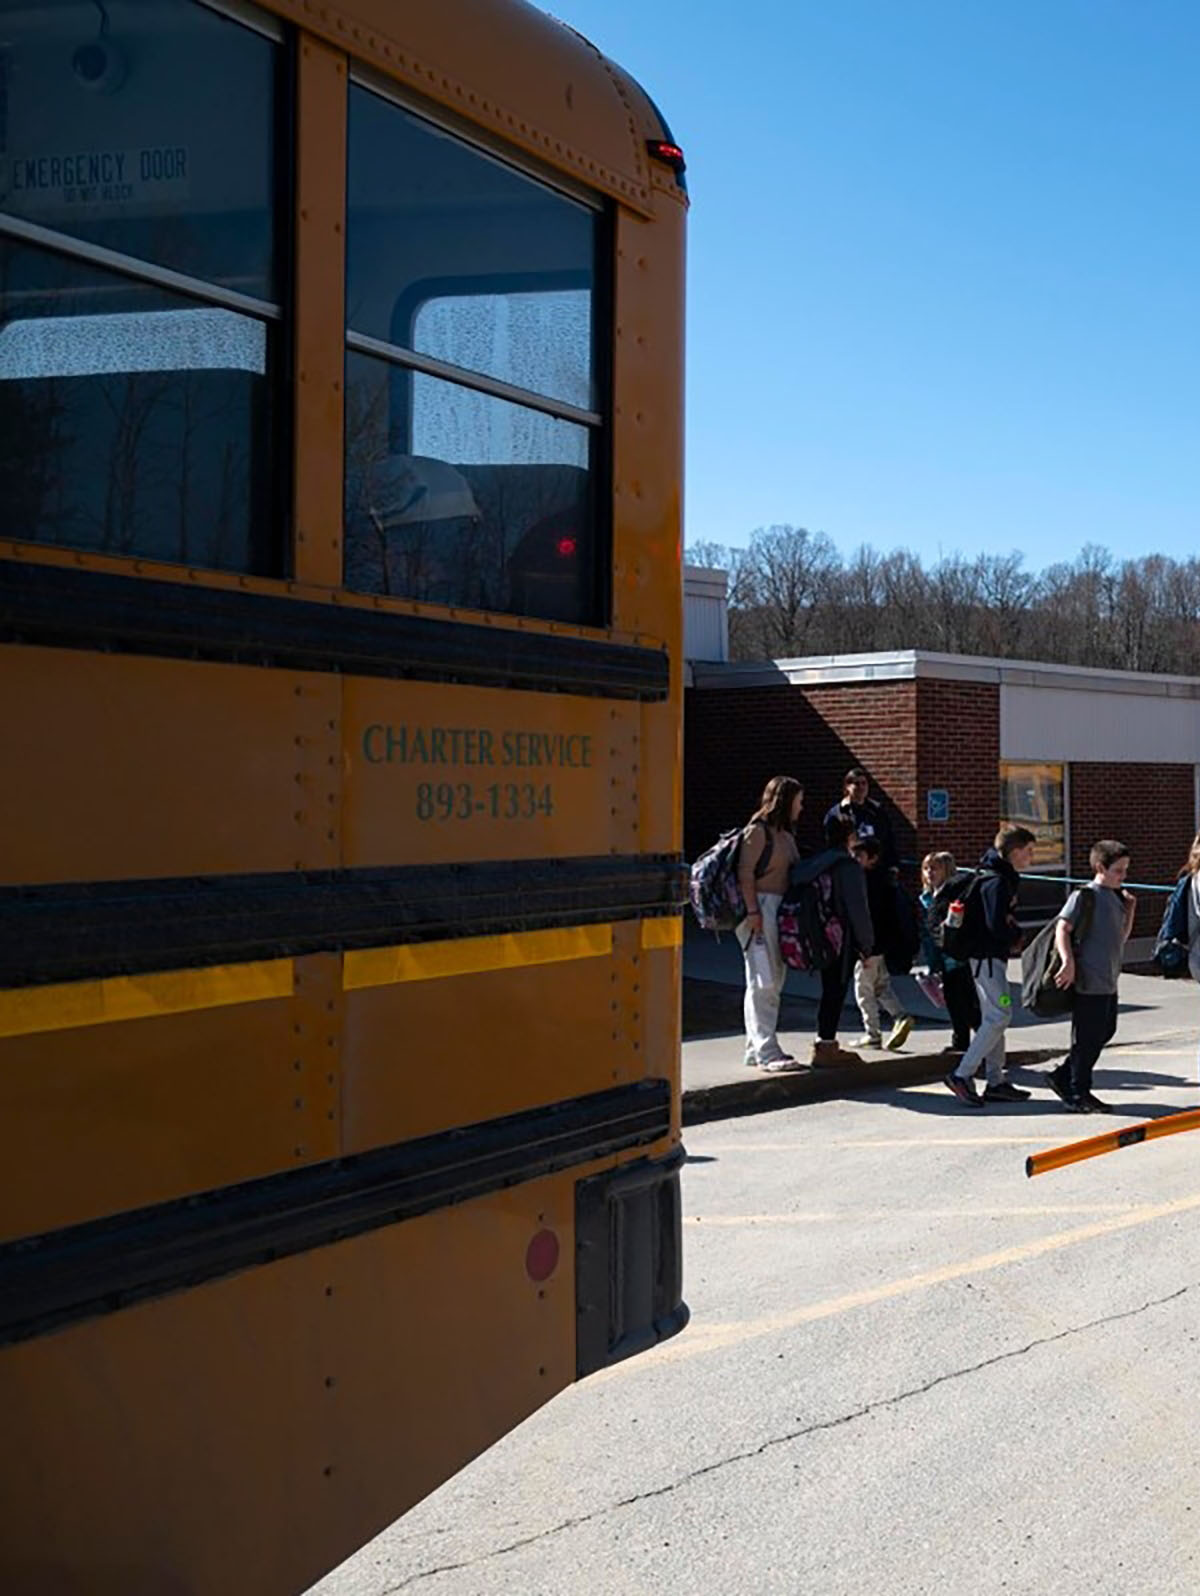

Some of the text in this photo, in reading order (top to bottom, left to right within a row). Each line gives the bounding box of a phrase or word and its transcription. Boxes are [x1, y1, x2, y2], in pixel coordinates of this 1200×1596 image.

[13, 147, 187, 190] EMERGENCY DOOR
[362, 724, 593, 768] CHARTER SERVICE
[415, 782, 554, 821] 893-1334
